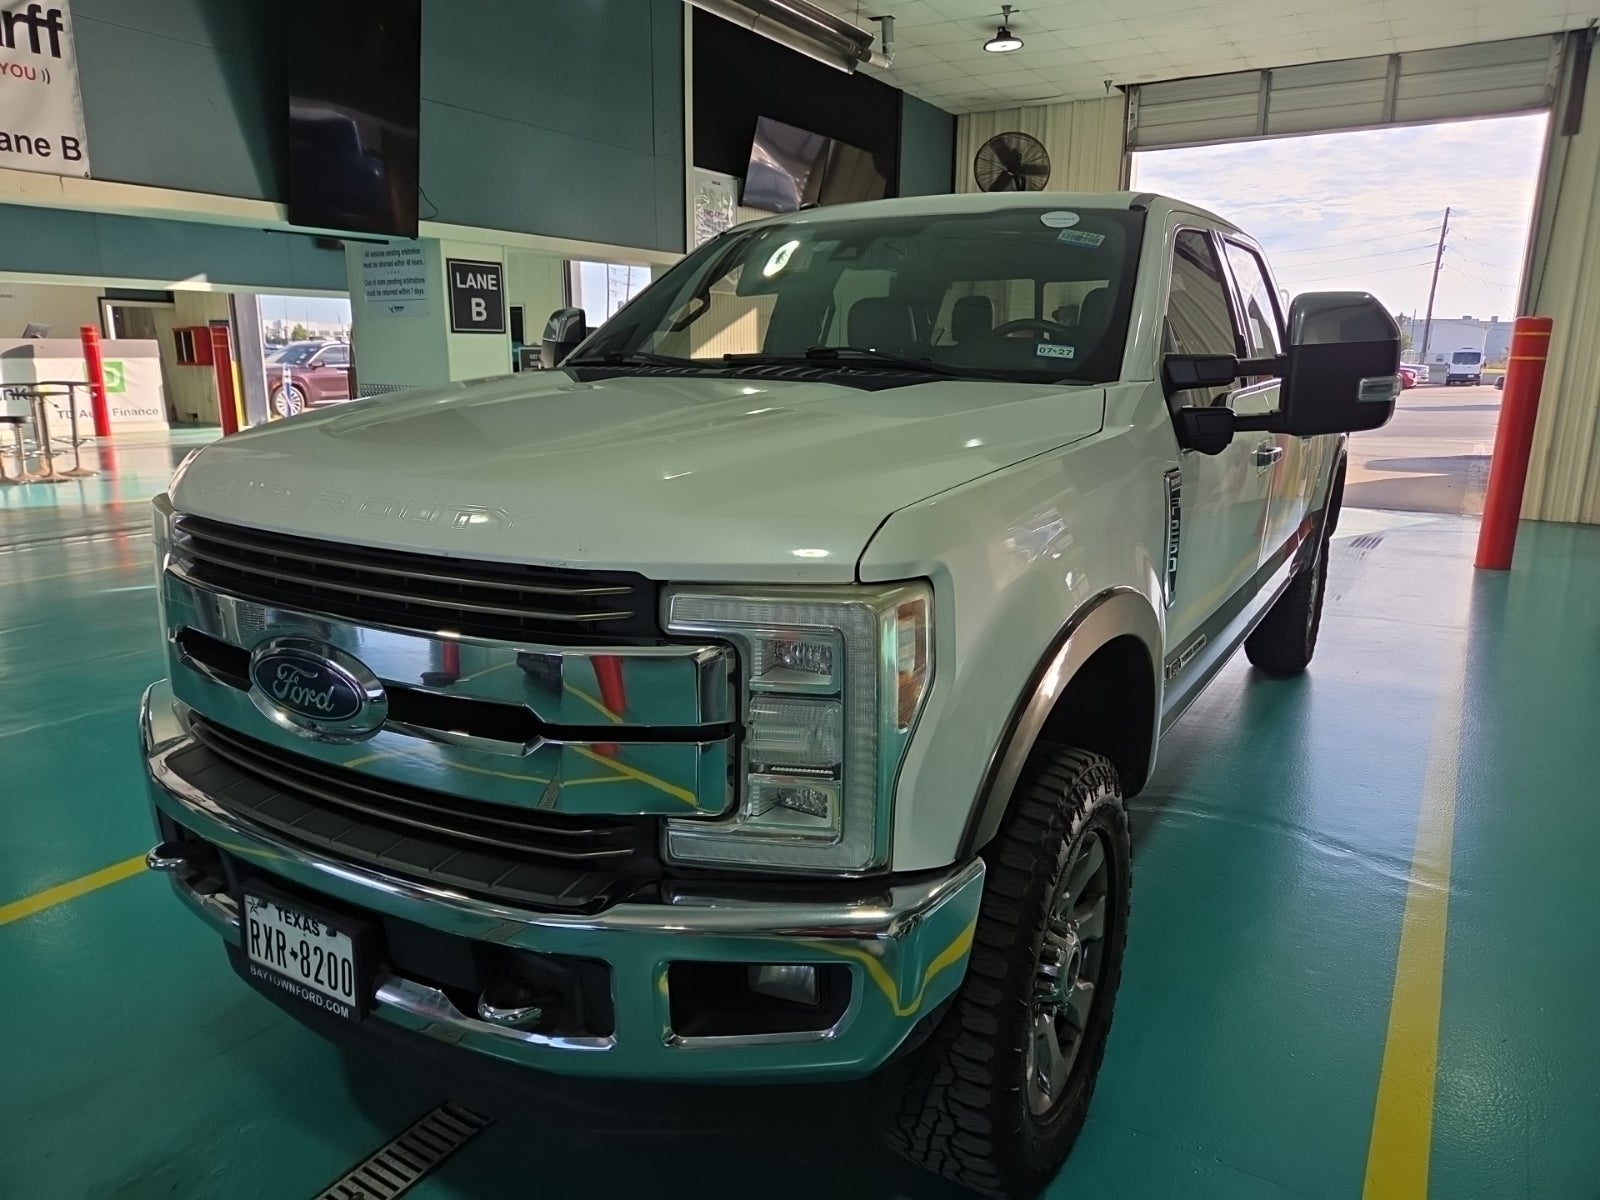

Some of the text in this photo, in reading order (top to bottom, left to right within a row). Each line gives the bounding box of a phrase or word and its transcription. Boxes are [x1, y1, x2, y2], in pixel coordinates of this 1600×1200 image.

[0, 3, 64, 59] rff
[0, 62, 36, 81] YOU
[60, 135, 82, 161] B
[456, 271, 498, 291] LANE
[471, 297, 488, 322] B
[1039, 346, 1072, 356] 07 27
[112, 406, 160, 418] Finance
[272, 662, 335, 714] Ford
[275, 904, 321, 937] TEXAS
[250, 918, 353, 998] RXR 8200
[249, 964, 349, 1019] BAYTOWNFORD.COM
